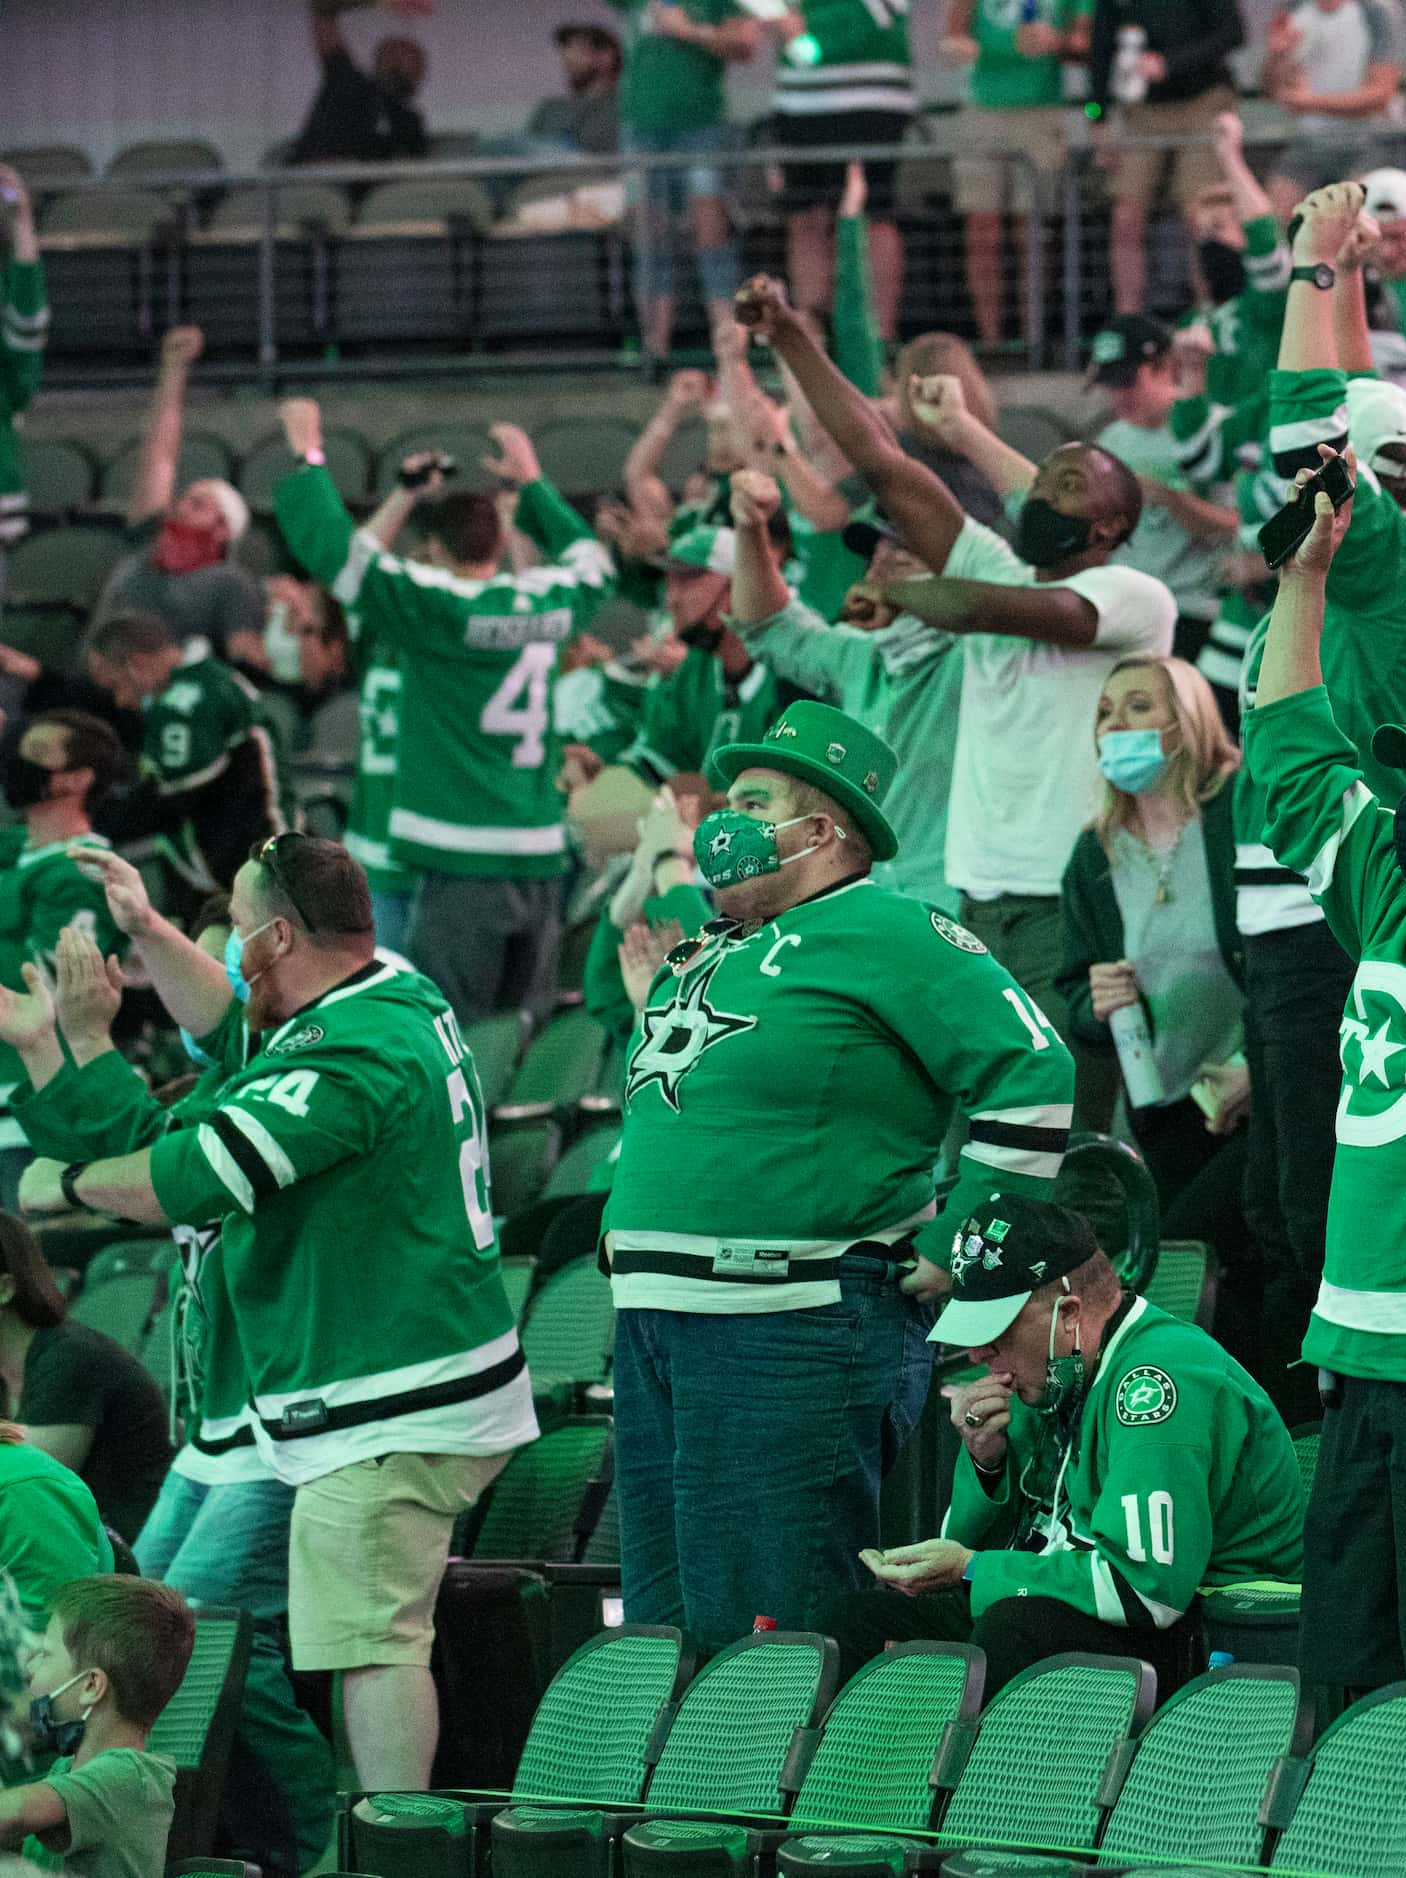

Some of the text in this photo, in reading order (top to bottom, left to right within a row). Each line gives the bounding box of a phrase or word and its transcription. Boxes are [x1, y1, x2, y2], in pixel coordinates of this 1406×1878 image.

[480, 642, 557, 768] 4
[760, 934, 802, 976] C
[1119, 1369, 1171, 1401] DALLAS
[1122, 1404, 1170, 1421] STARS
[1121, 1490, 1174, 1567] 10
